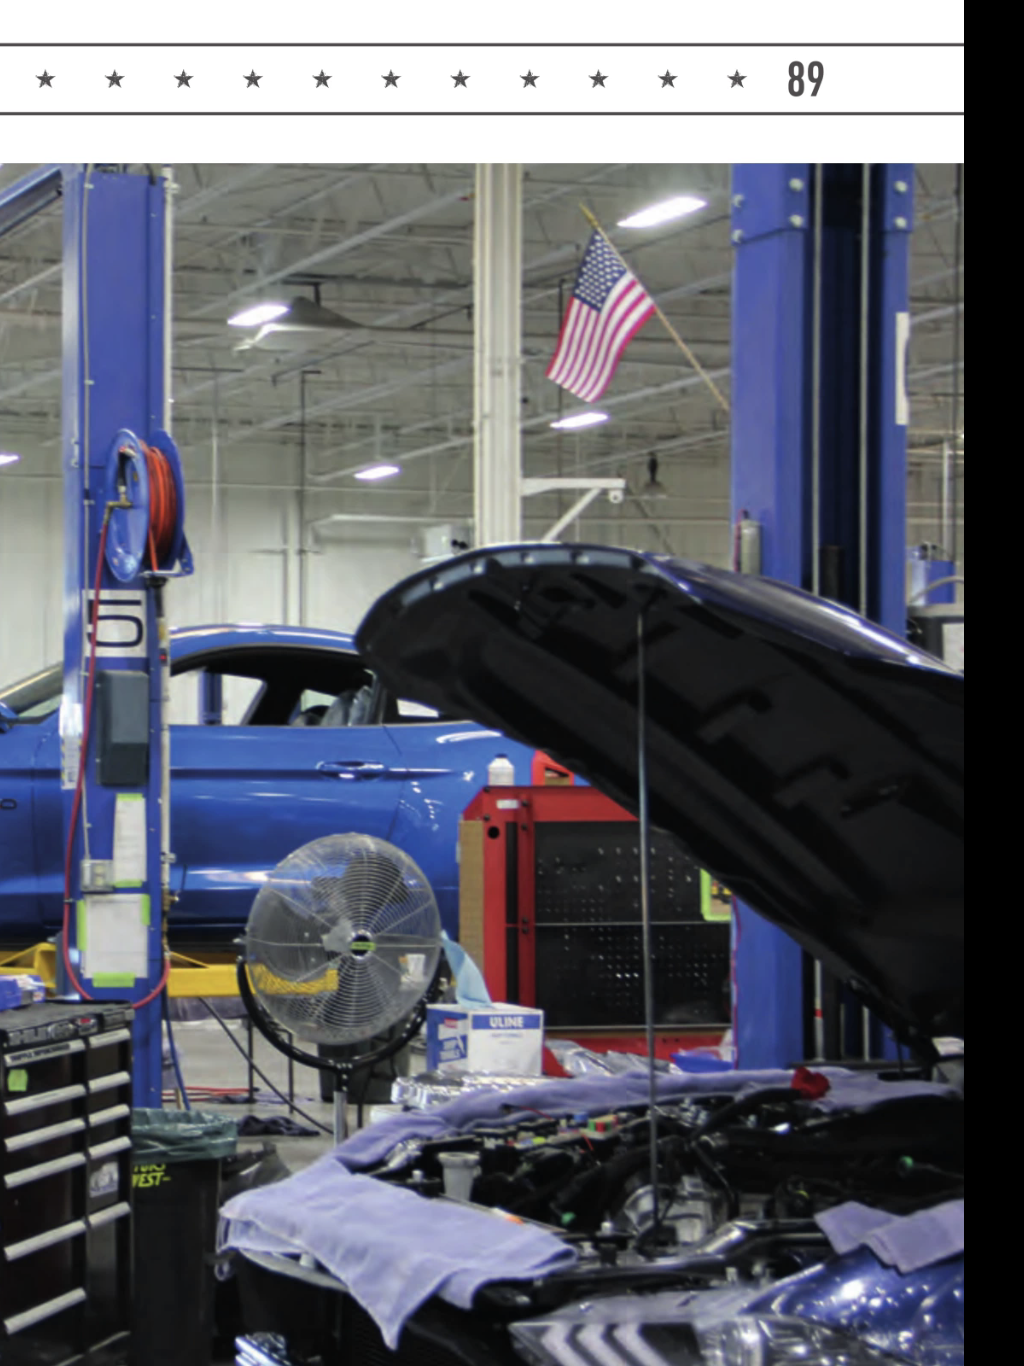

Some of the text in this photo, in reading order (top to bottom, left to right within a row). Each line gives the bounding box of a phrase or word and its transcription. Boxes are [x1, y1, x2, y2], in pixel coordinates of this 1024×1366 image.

[788, 61, 824, 97] 89
[86, 599, 144, 649] 5
[489, 1016, 524, 1028] ULINE
